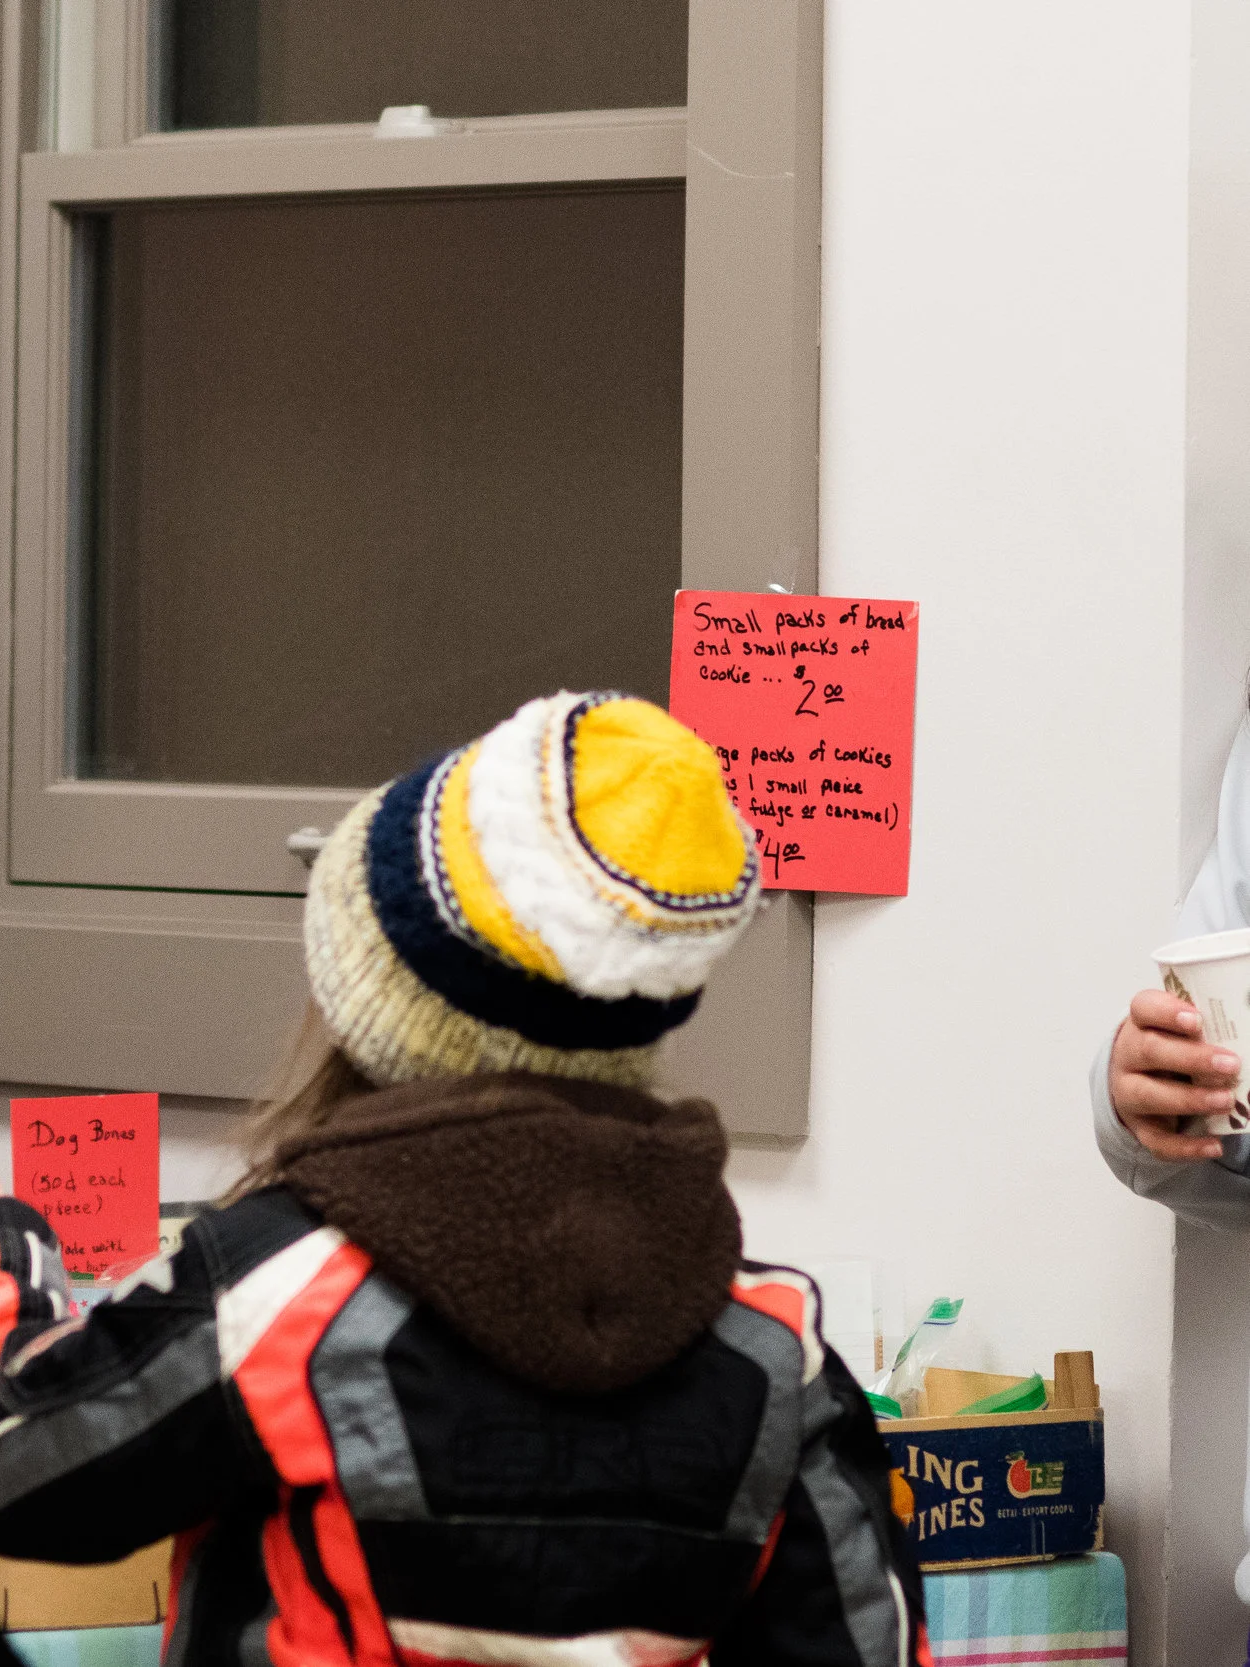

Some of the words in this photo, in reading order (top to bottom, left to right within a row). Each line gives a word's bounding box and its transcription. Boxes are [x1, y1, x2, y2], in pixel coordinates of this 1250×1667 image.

[694, 602, 761, 633] Small
[776, 609, 825, 635] packs
[839, 604, 859, 625] of
[866, 605, 905, 630] bread
[694, 638, 731, 656] and
[743, 641, 785, 656] small
[791, 637, 838, 658] packs
[851, 640, 869, 655] of
[751, 746, 795, 766] packs
[809, 739, 826, 761] of
[835, 747, 892, 769] cookies
[766, 779, 807, 795] small
[749, 797, 794, 827] fudge
[802, 805, 817, 819] or
[826, 802, 899, 830] caramel)
[28, 1120, 79, 1155] Dog
[88, 1119, 136, 1142] Bones
[88, 1167, 125, 1187] each
[906, 1445, 984, 1494] ING
